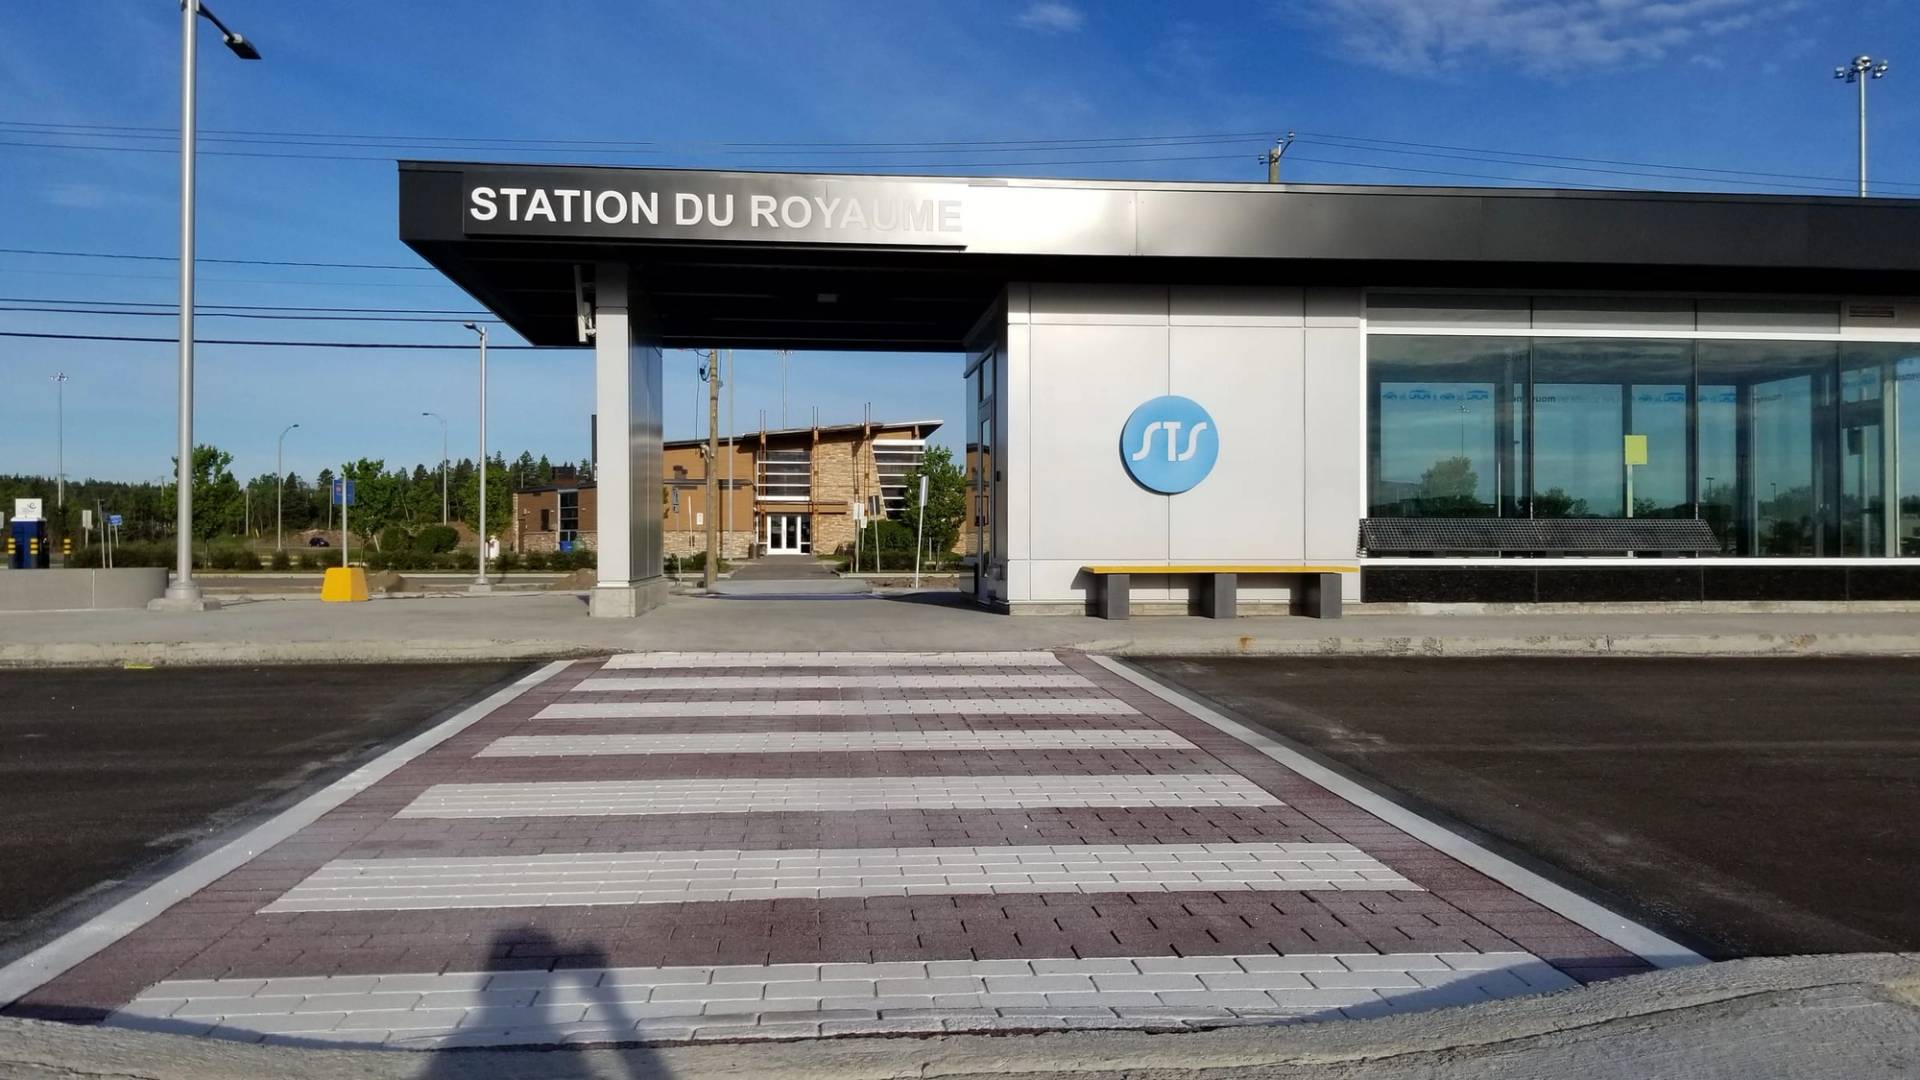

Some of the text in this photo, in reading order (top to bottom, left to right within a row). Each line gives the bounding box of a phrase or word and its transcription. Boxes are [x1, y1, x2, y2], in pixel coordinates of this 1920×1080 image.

[470, 187, 963, 233] STATION DU ROYAUME
[1132, 421, 1207, 462] STS
